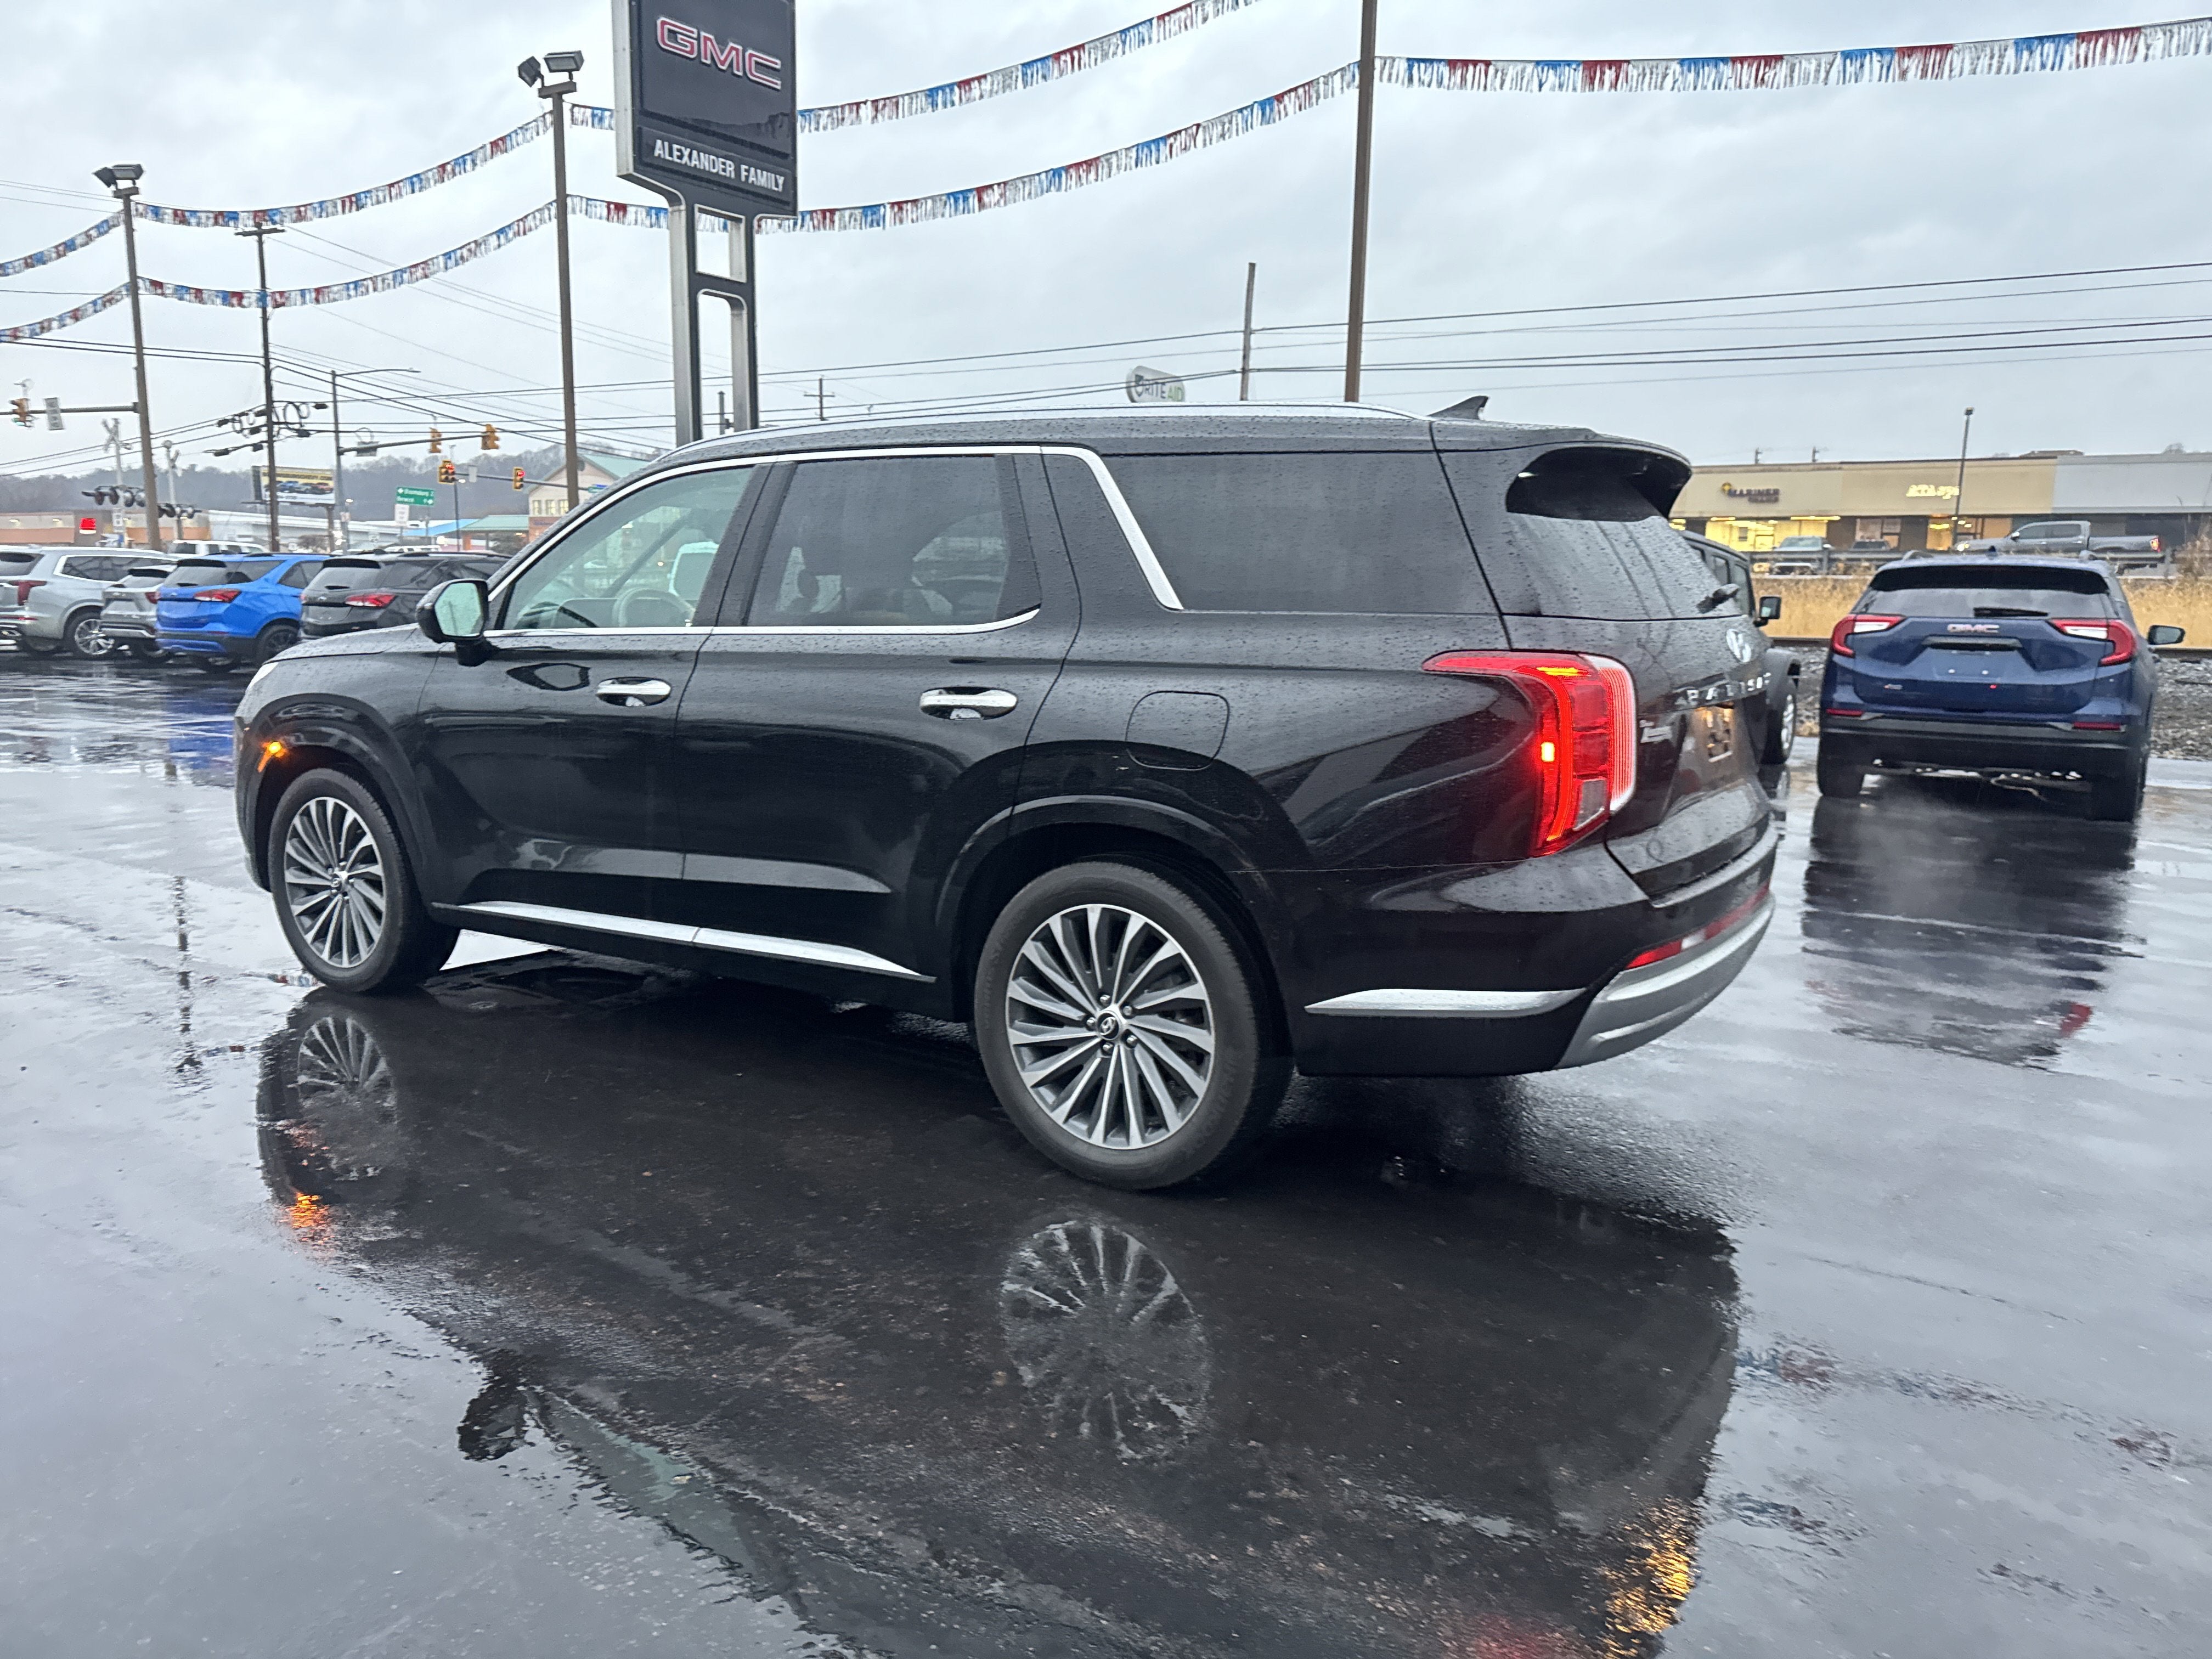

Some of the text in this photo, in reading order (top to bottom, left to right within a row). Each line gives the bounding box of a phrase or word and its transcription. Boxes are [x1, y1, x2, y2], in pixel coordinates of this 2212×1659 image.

[657, 17, 781, 90] GMC
[654, 139, 785, 192] ALEXANDER FAMILY
[1145, 380, 1183, 402] RITE AID
[1948, 623, 2000, 633] GMC
